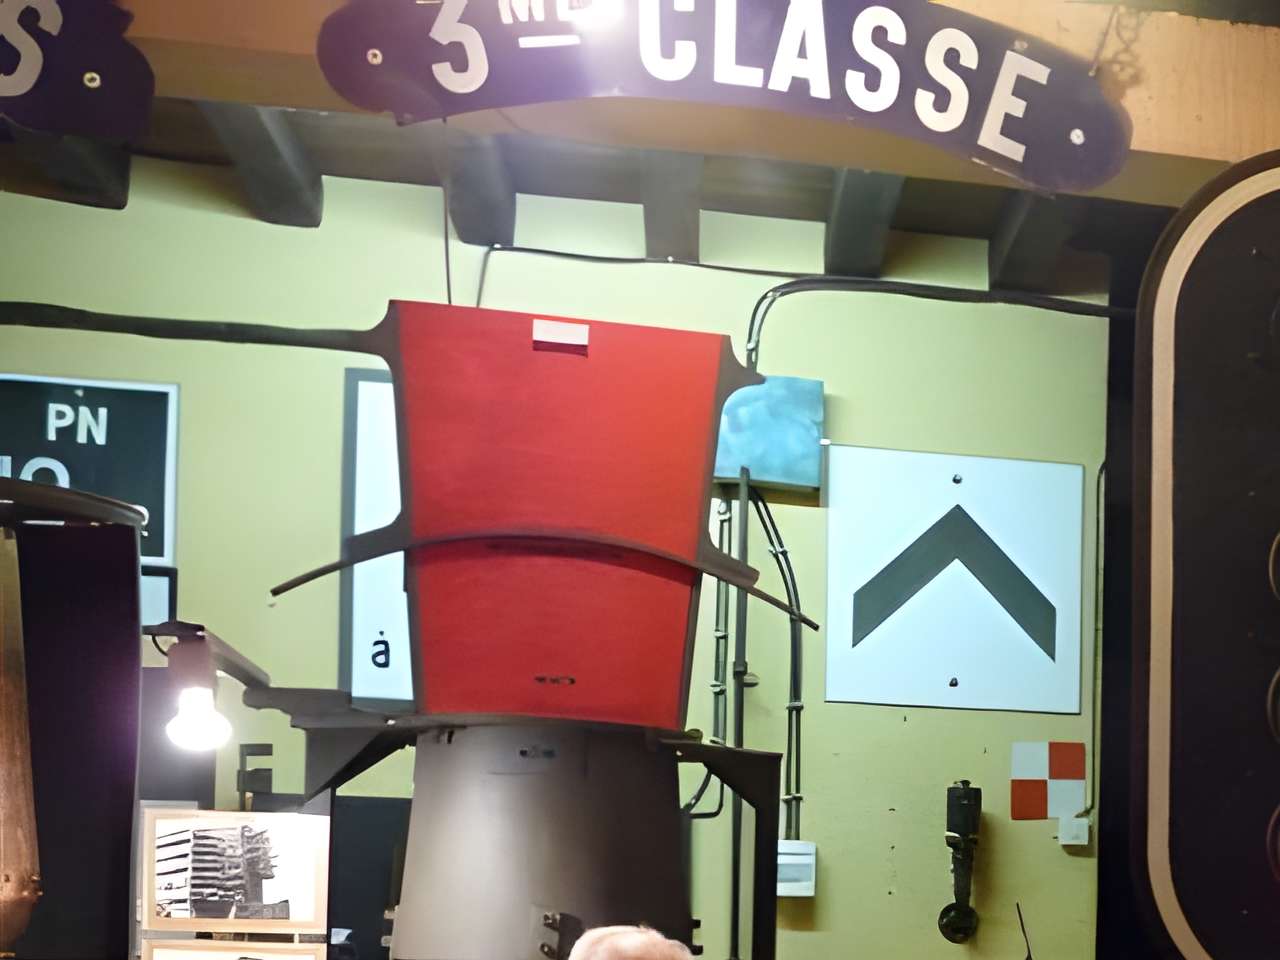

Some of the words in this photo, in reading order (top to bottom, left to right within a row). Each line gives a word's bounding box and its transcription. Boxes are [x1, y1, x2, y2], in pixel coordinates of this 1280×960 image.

[429, 0, 489, 93] 3
[639, 0, 1051, 163] CLASSE
[47, 403, 108, 446] PN
